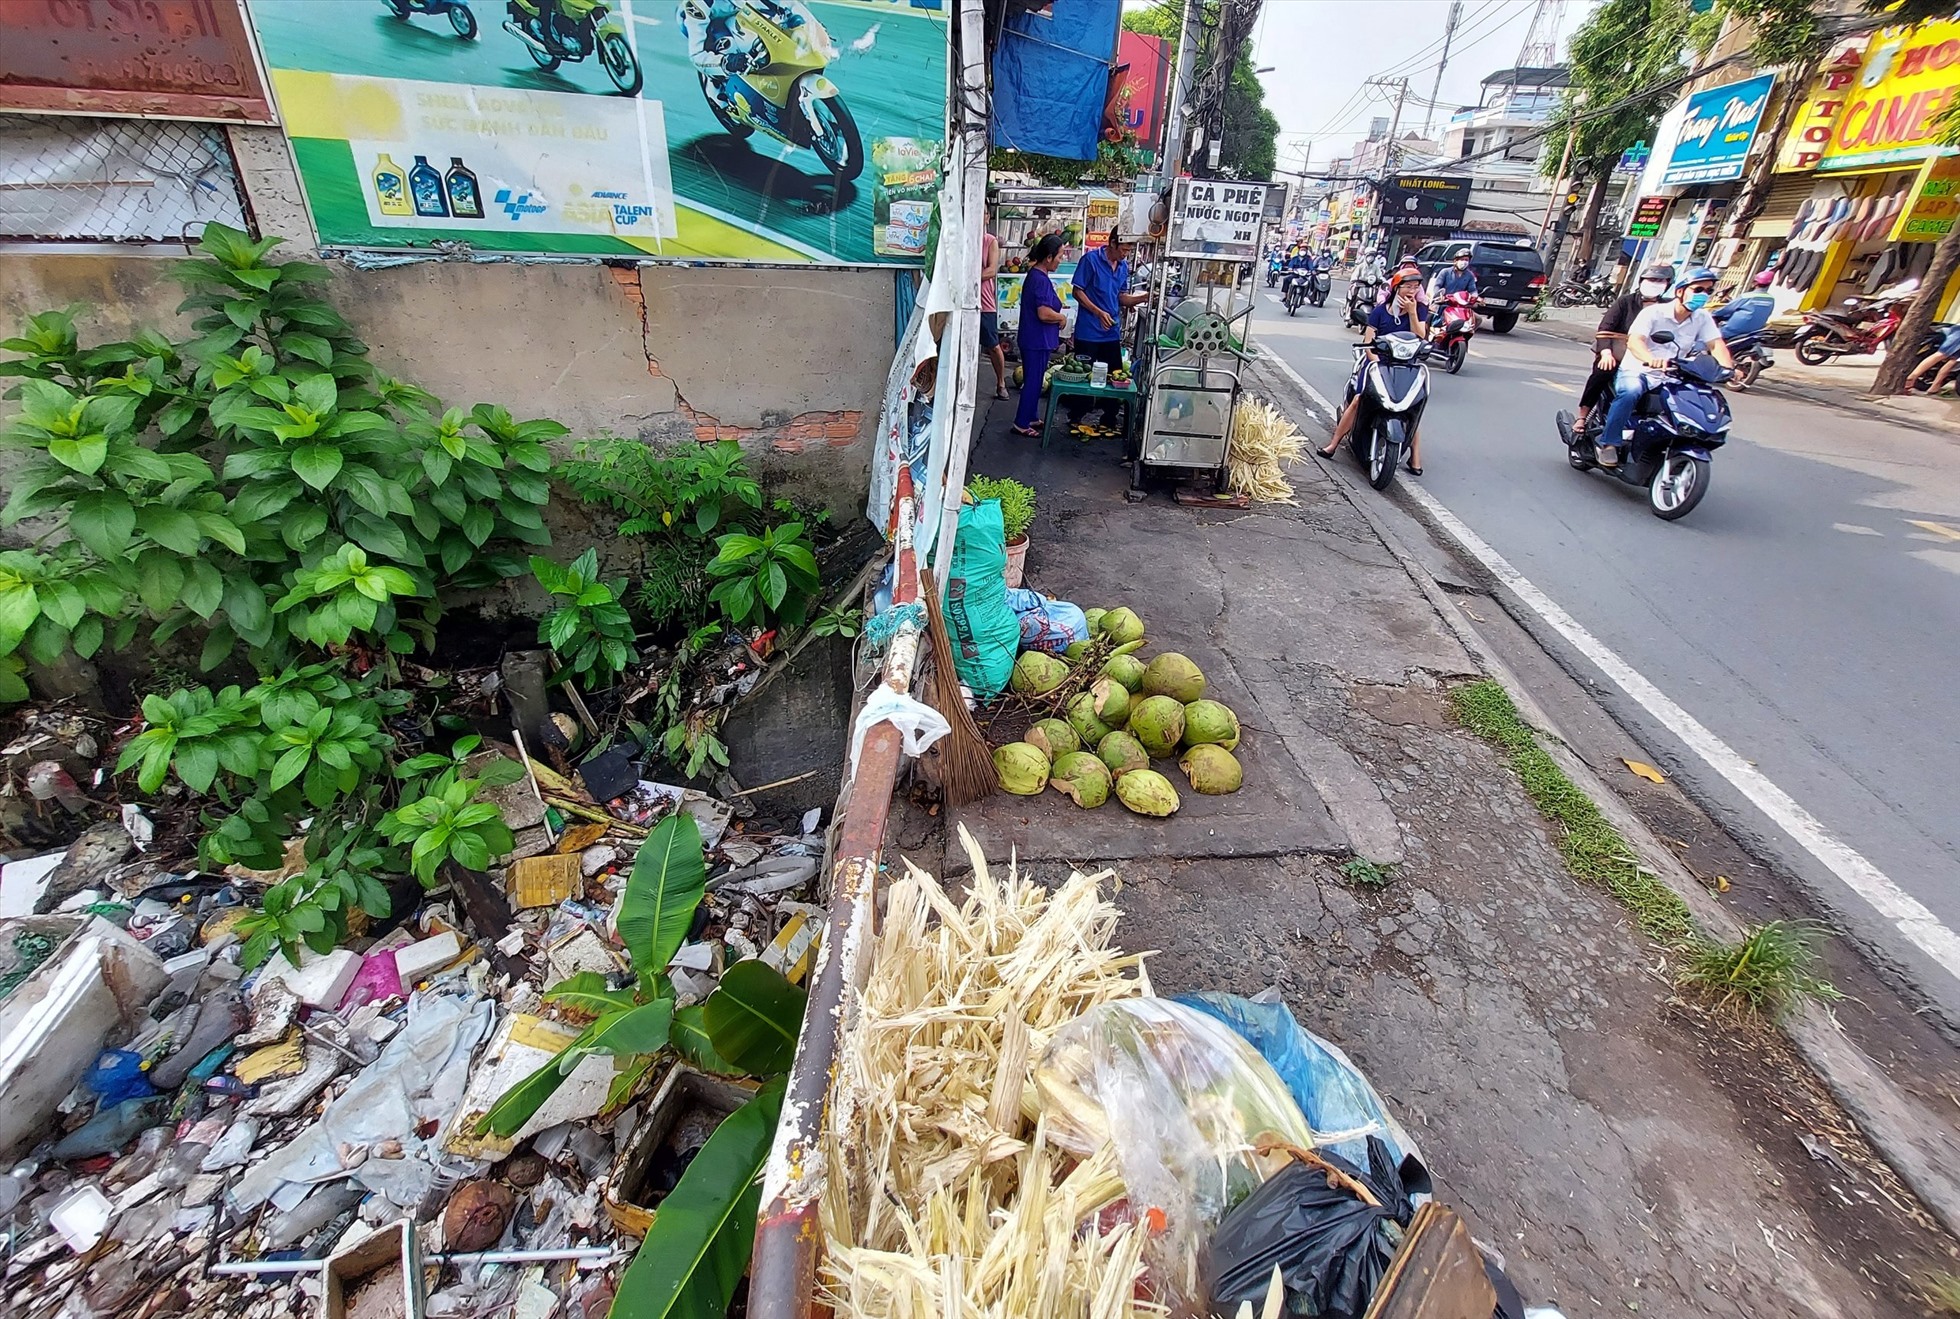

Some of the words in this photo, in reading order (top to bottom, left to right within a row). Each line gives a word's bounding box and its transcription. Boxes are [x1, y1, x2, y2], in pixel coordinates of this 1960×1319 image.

[755, 19, 782, 44] STANLEY
[1793, 31, 1872, 169] APTOP
[1400, 177, 1422, 188] NHẤT
[1423, 180, 1446, 189] LONG
[591, 190, 629, 200] ADVANCE
[1191, 183, 1215, 202] CÀ
[1223, 182, 1262, 205] PHÊ
[613, 204, 654, 217] TALENT
[1187, 206, 1221, 220] NƯỚC
[1225, 210, 1260, 225] NGỌT
[615, 215, 638, 227] CUP
